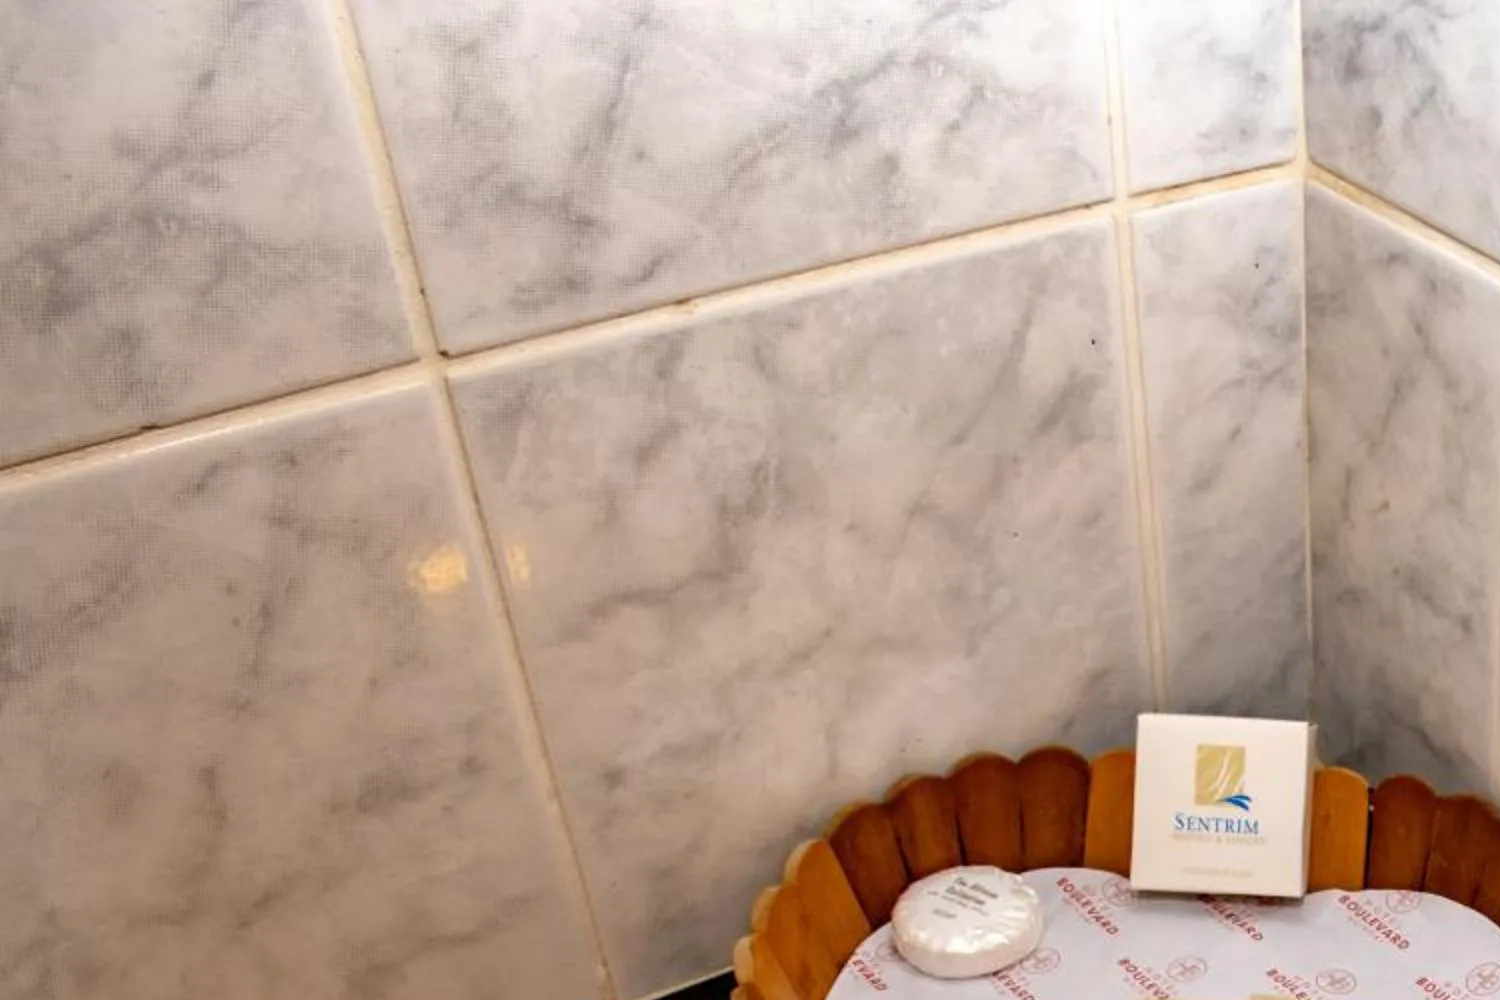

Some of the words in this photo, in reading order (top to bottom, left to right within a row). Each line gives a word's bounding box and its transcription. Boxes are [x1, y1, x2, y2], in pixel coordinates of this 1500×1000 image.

[1174, 812, 1259, 835] SENTRIM
[1338, 895, 1410, 950] BOULEVARD
[851, 959, 888, 991] EVARD
